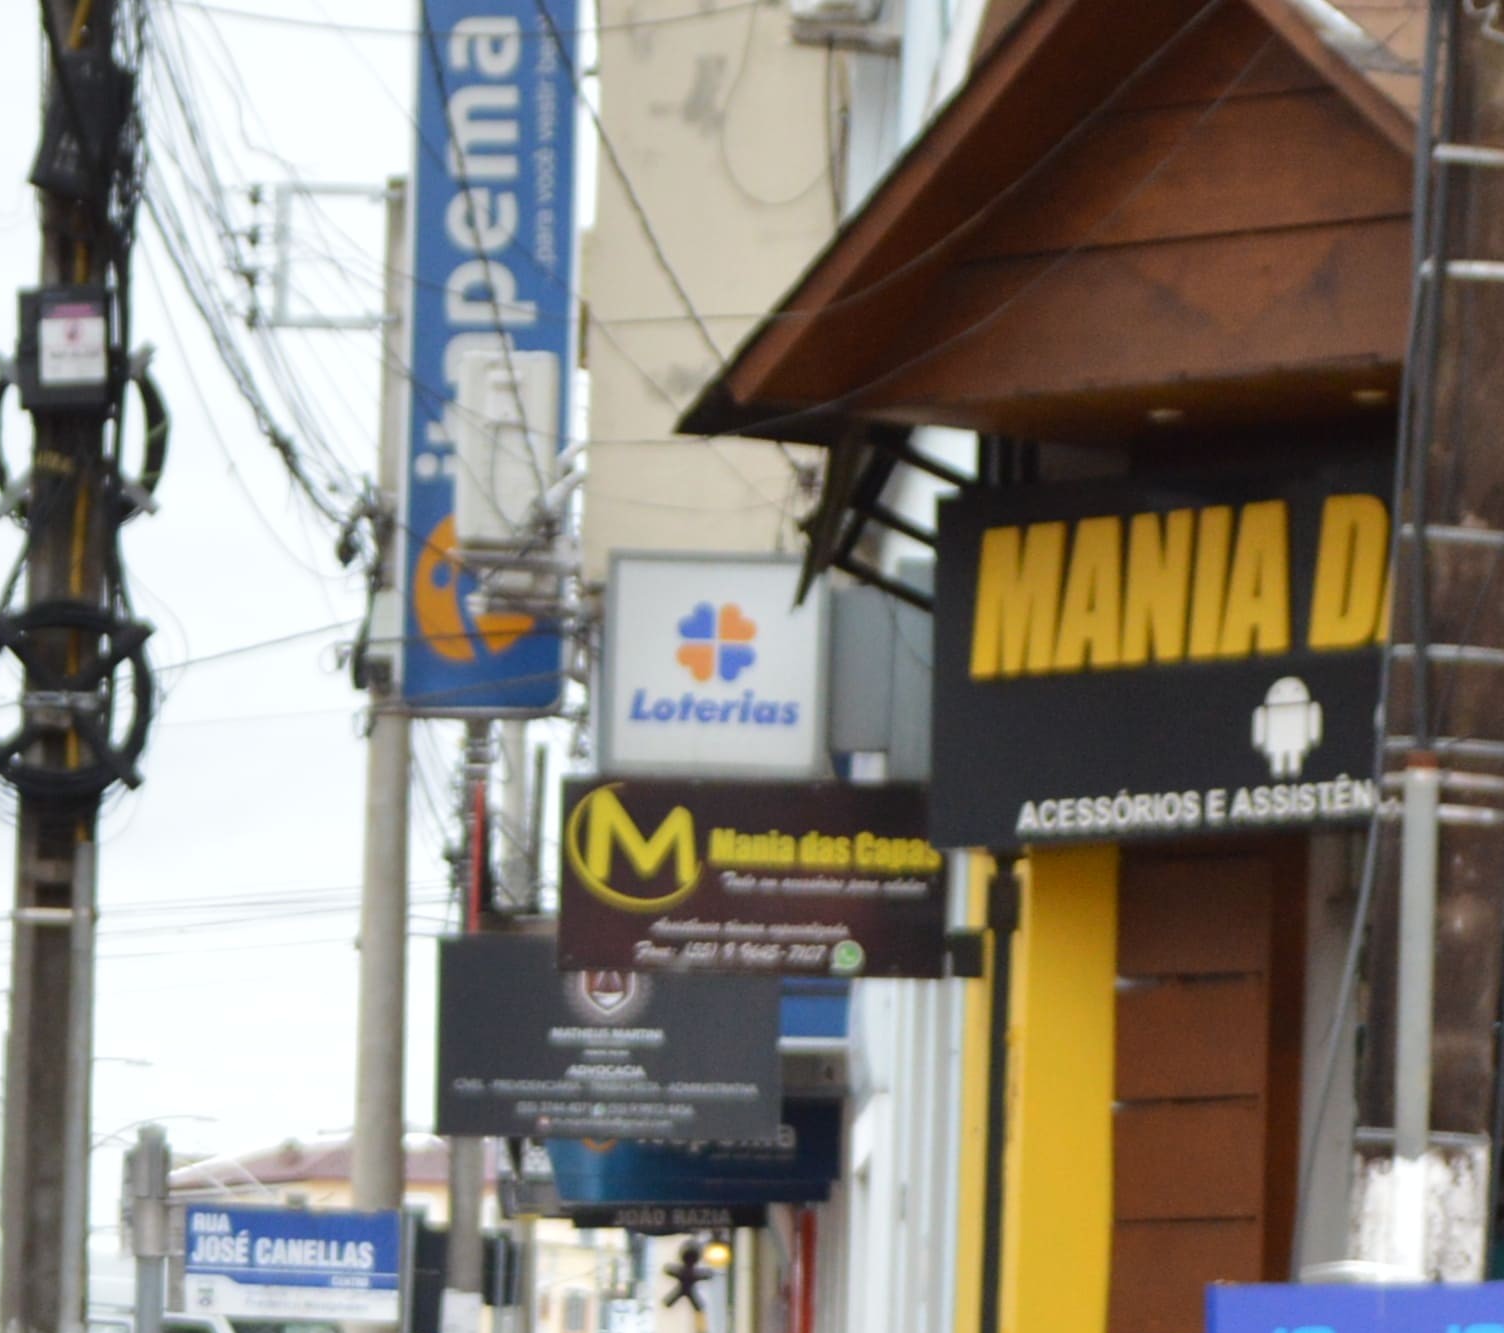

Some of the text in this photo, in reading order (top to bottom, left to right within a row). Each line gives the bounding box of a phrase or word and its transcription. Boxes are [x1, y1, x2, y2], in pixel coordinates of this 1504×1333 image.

[971, 499, 1292, 682] MANIA
[629, 689, 799, 727] Loterias
[1017, 789, 1201, 834] ACESSÓRIOS
[1205, 789, 1228, 820] E
[709, 828, 941, 873] Mania das Capas
[193, 1212, 230, 1232] RUA
[192, 1230, 375, 1270] JOSÉ CANELLAS
